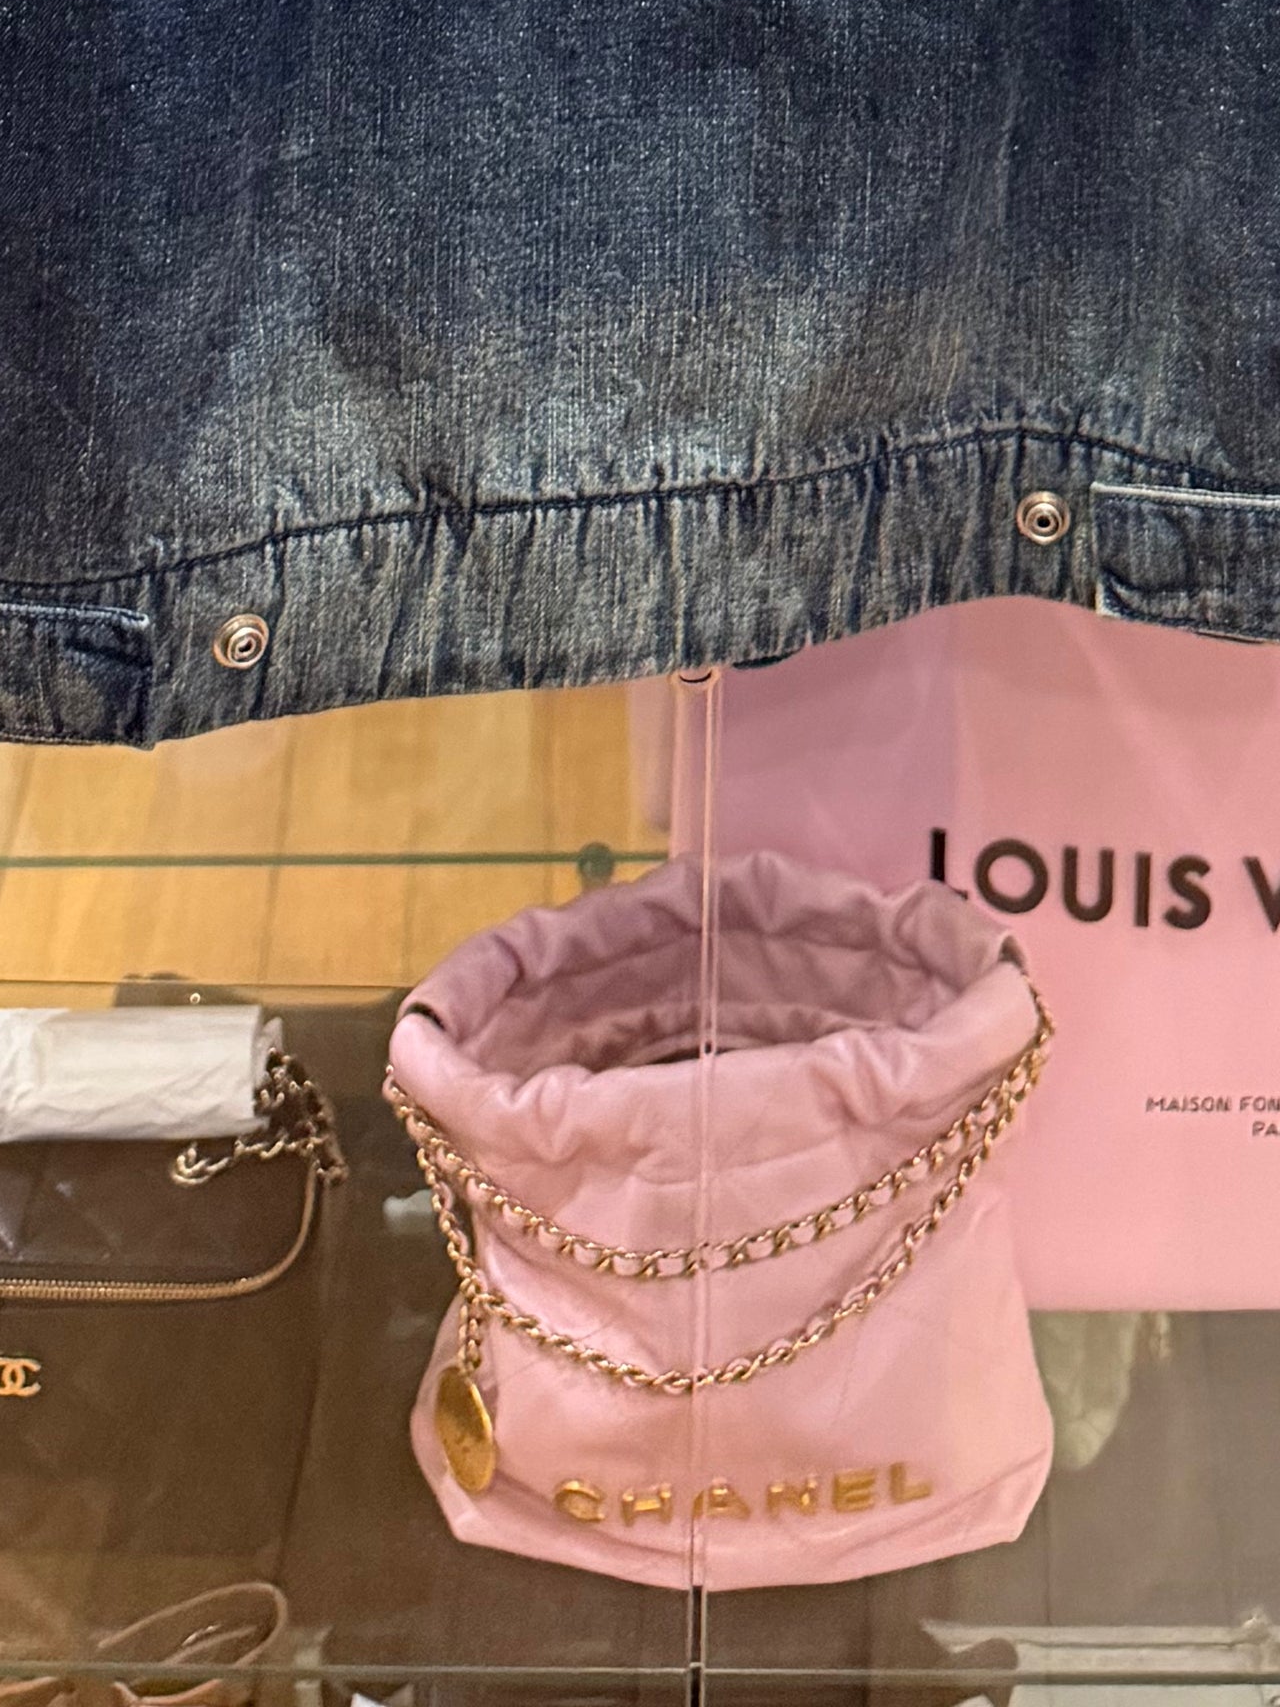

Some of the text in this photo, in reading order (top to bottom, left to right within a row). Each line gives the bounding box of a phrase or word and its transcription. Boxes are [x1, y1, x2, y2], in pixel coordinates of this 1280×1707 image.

[930, 827, 1212, 930] LOUIS
[1145, 1095, 1231, 1113] MAISON
[554, 1462, 933, 1527] CHANEL
